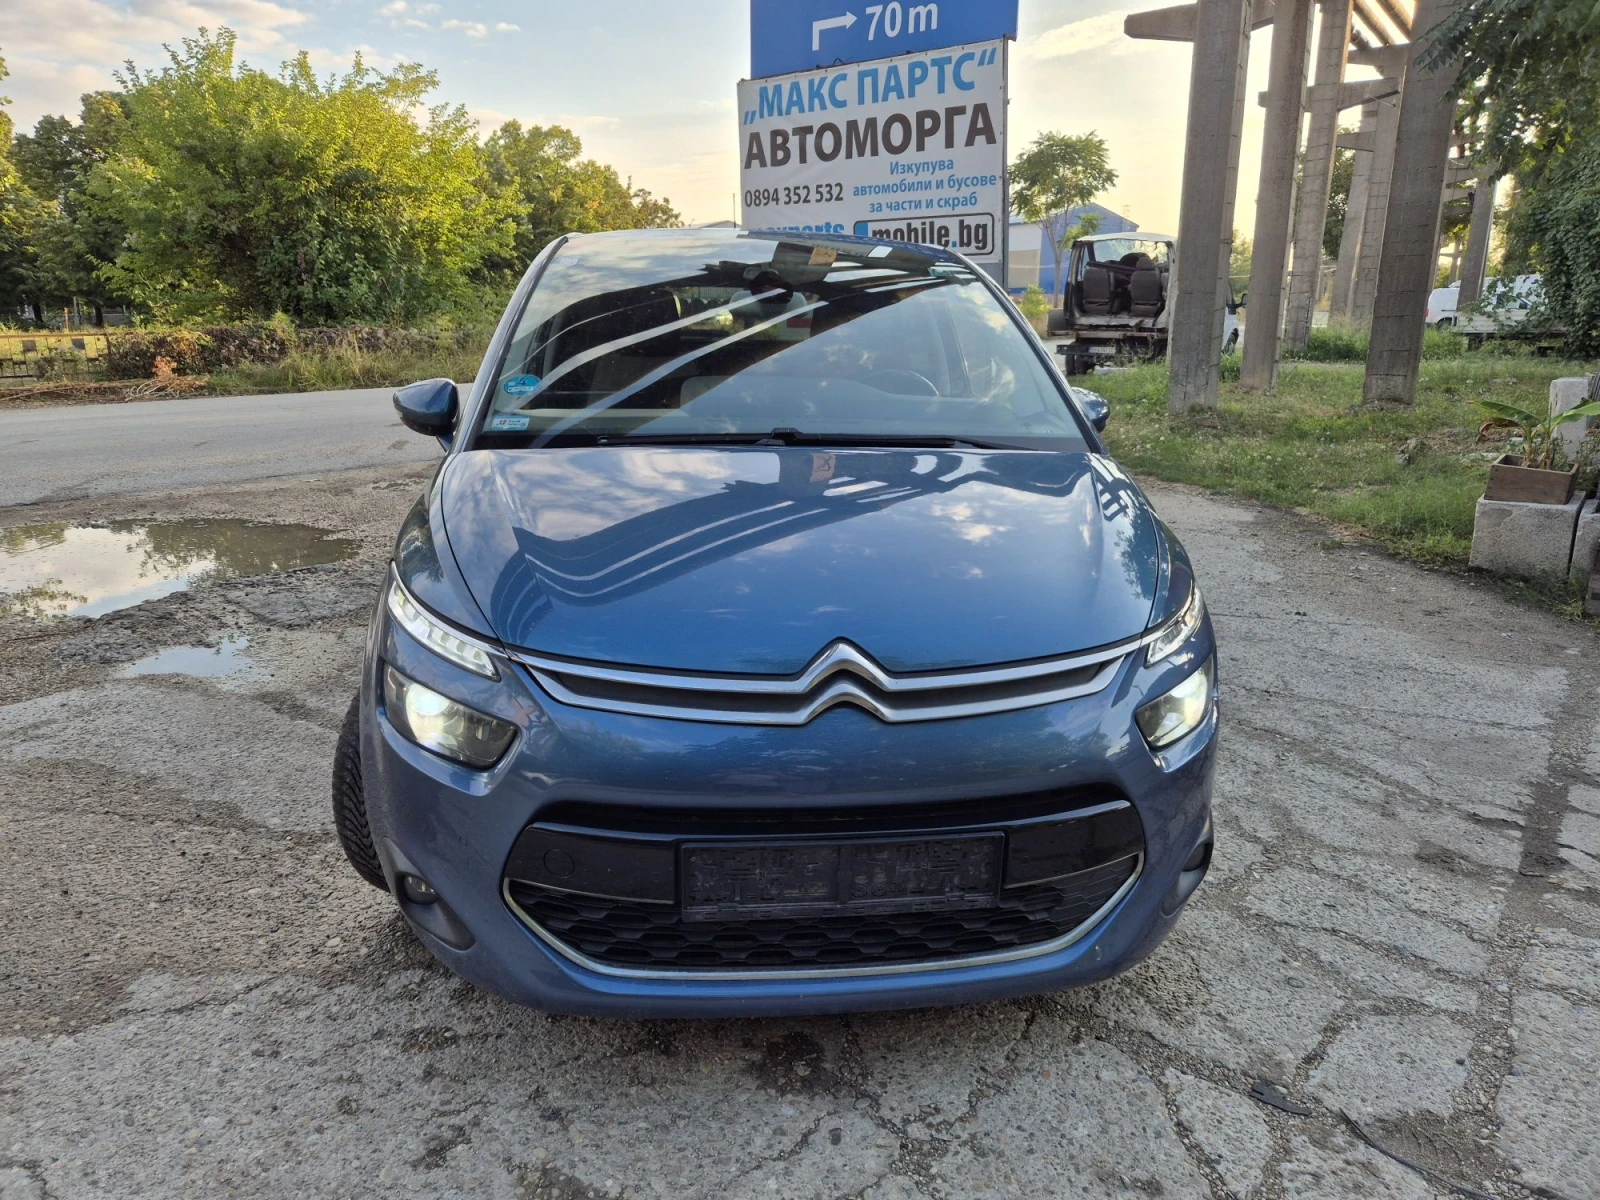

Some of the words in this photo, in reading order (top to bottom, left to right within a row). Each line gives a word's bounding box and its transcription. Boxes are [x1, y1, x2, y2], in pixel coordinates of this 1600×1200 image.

[865, 1, 901, 41] 70
[907, 2, 938, 34] m
[744, 102, 997, 170] АВТОМОРГА
[889, 159, 954, 176] Изкупува
[744, 187, 780, 208] 0894
[783, 184, 811, 206] 352
[815, 182, 844, 204] 532
[853, 178, 932, 197] автомобили
[936, 179, 944, 190] и
[947, 174, 997, 192] бусове
[869, 202, 883, 213] за
[886, 199, 922, 212] части
[925, 198, 934, 209] и
[937, 191, 978, 211] скраб
